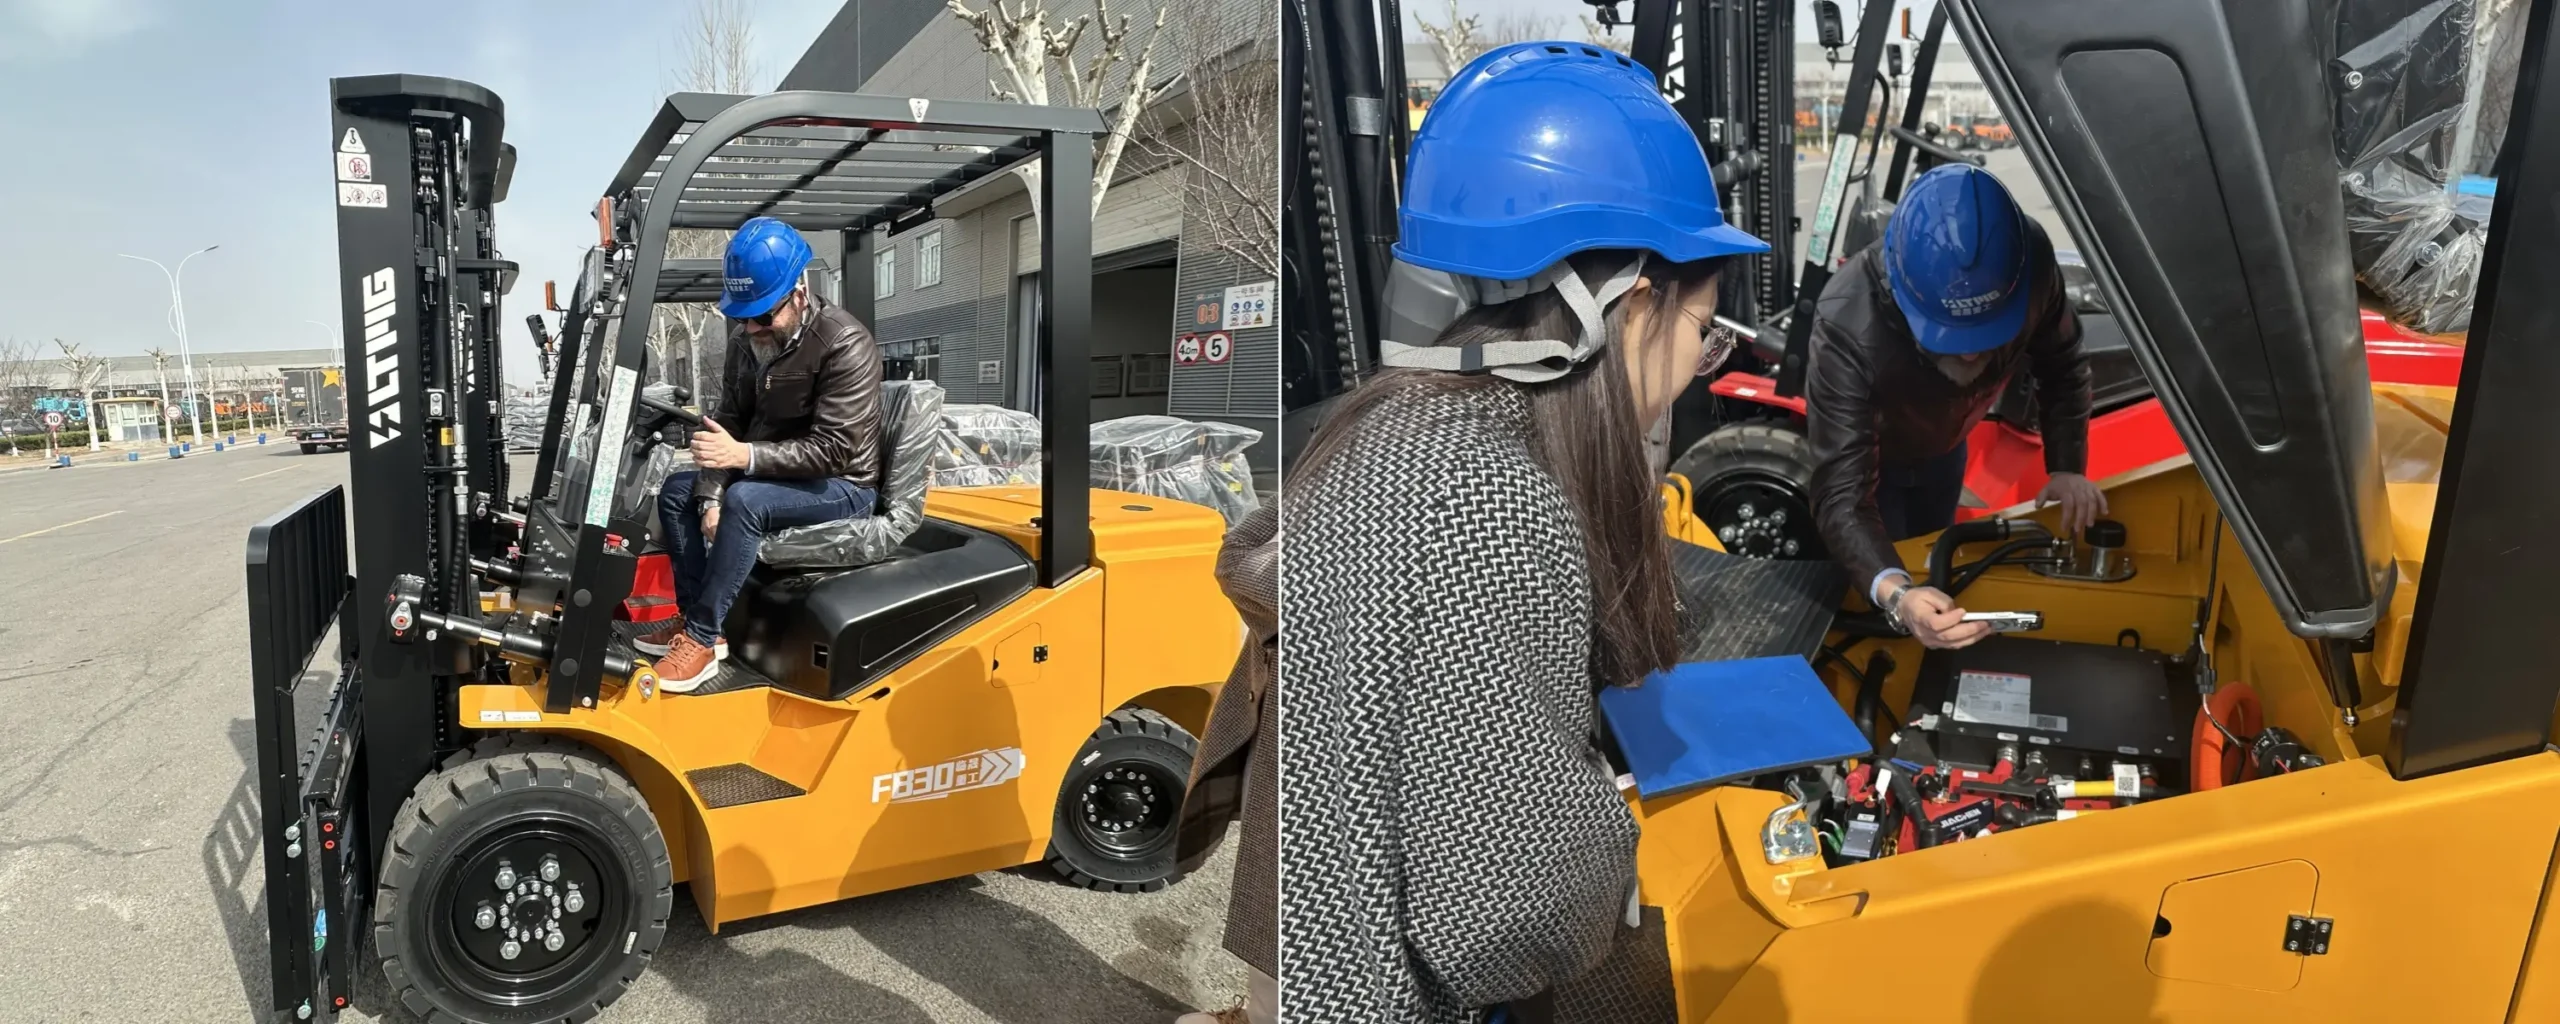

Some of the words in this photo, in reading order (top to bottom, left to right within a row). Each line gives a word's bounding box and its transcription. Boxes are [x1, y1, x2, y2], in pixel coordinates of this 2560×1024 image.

[1197, 303, 1219, 324] 03
[1211, 338, 1222, 357] 5
[49, 412, 59, 424] 10
